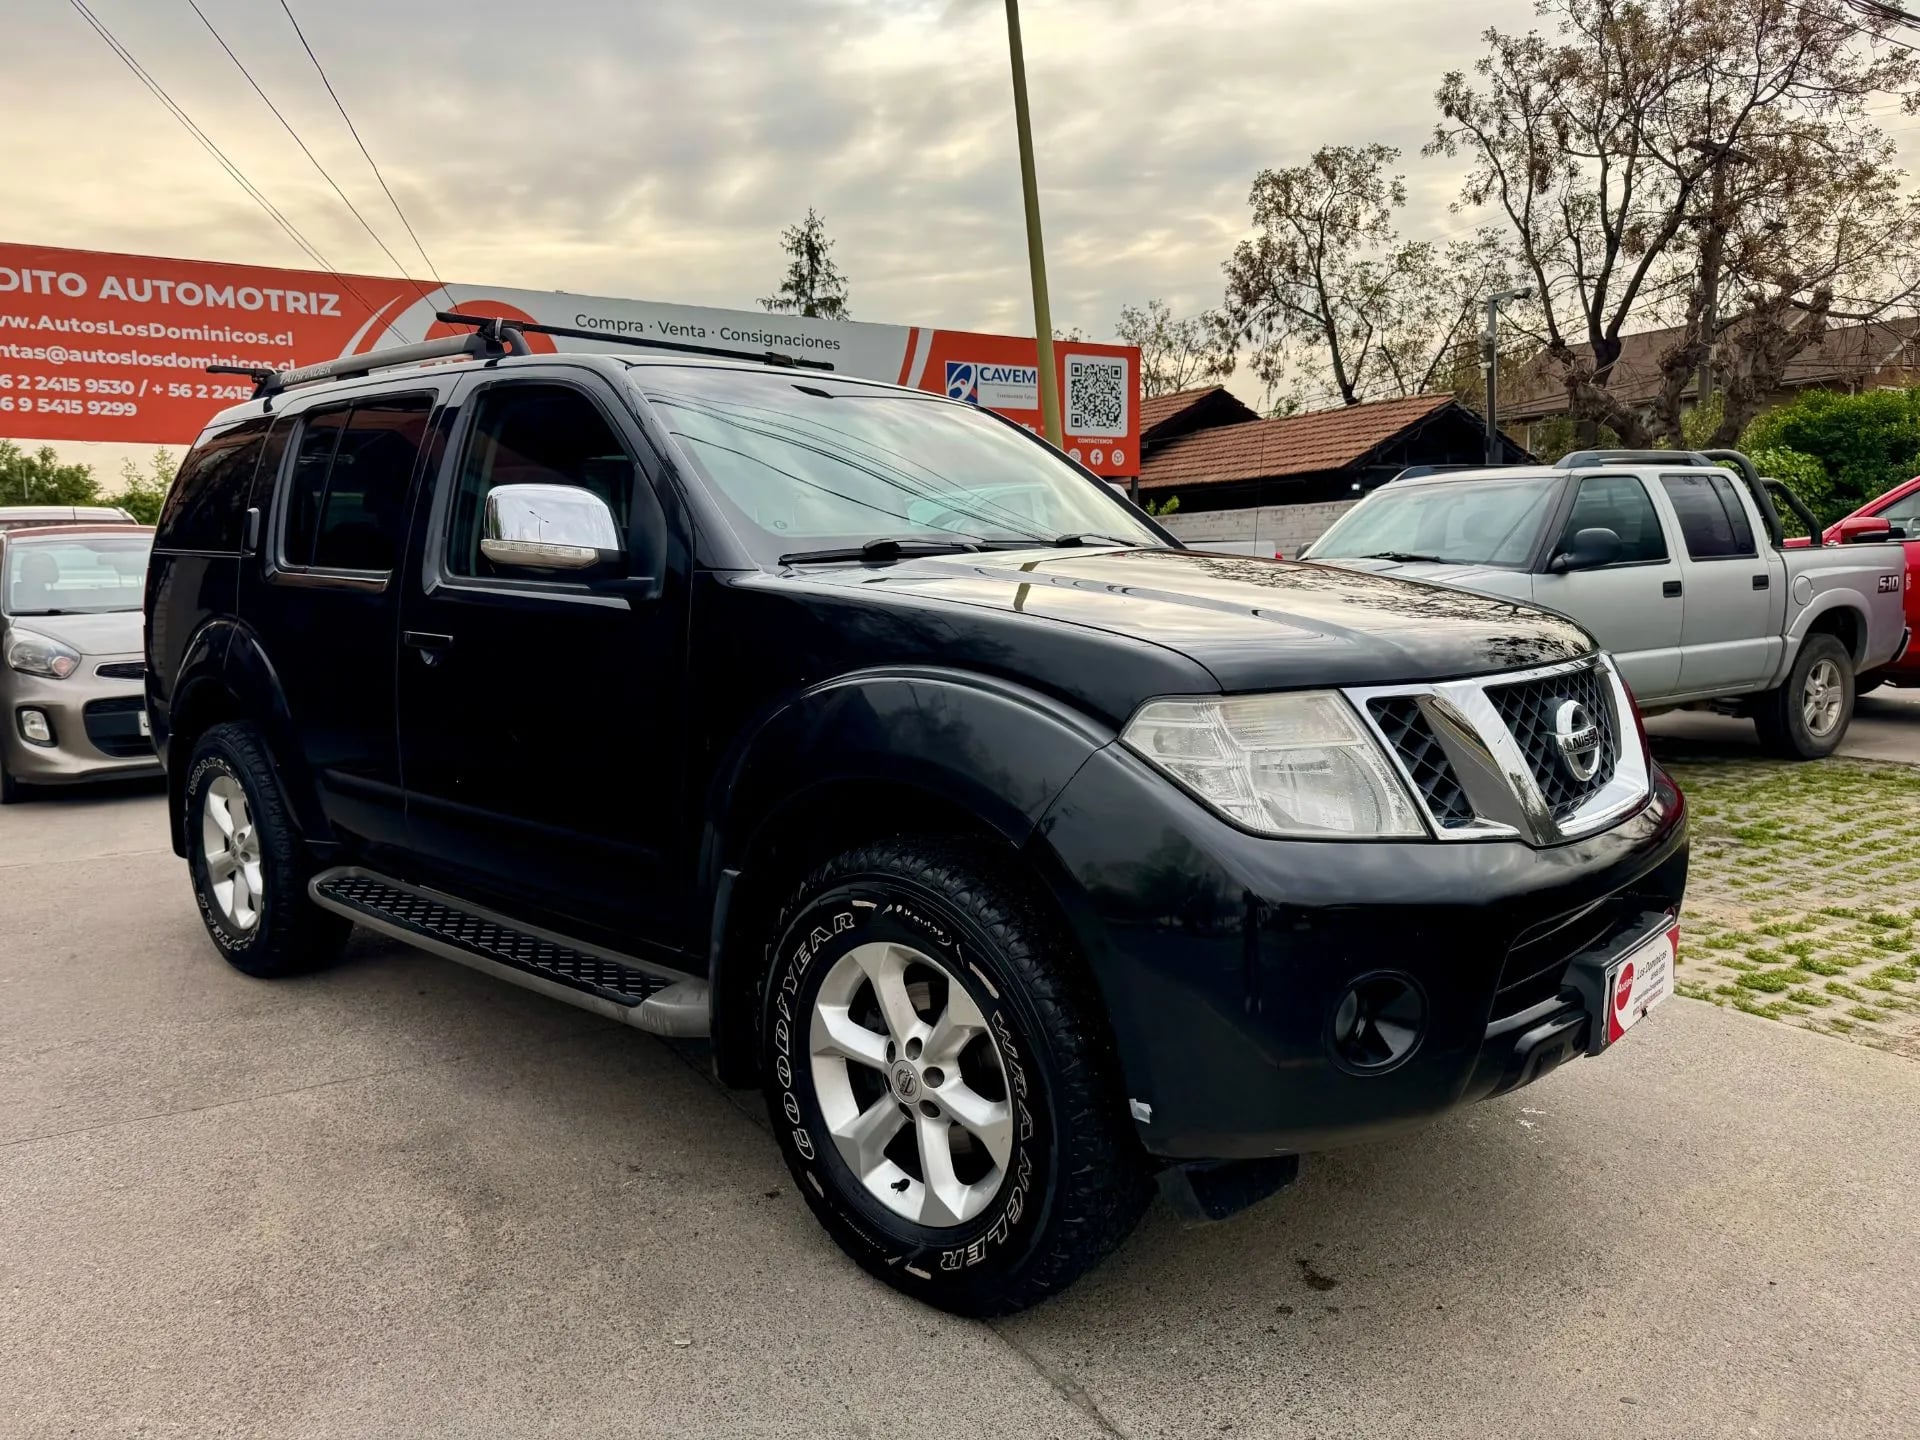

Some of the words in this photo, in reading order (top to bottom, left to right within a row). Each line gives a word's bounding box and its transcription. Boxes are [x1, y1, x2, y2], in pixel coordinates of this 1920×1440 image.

[99, 276, 342, 317] AUTOMOTRIZ
[575, 314, 644, 333] Compra
[657, 320, 706, 338] Venta
[720, 327, 840, 350] Consignaciones
[0, 344, 296, 371] ntas@autoslosdominicoscl
[17, 374, 31, 390] 2
[34, 376, 81, 392] 2415
[85, 378, 135, 395] 9530
[168, 383, 192, 397] 56
[196, 384, 208, 398] 2
[211, 385, 253, 400] 2415
[280, 364, 333, 385] PATHFINDER
[980, 366, 1036, 384] CAVEM
[18, 397, 33, 412] 9
[37, 398, 83, 414] 5415
[87, 400, 137, 416] 9299
[775, 911, 856, 1161] GOODYEAR
[940, 1009, 1034, 1271] WRANGLER
